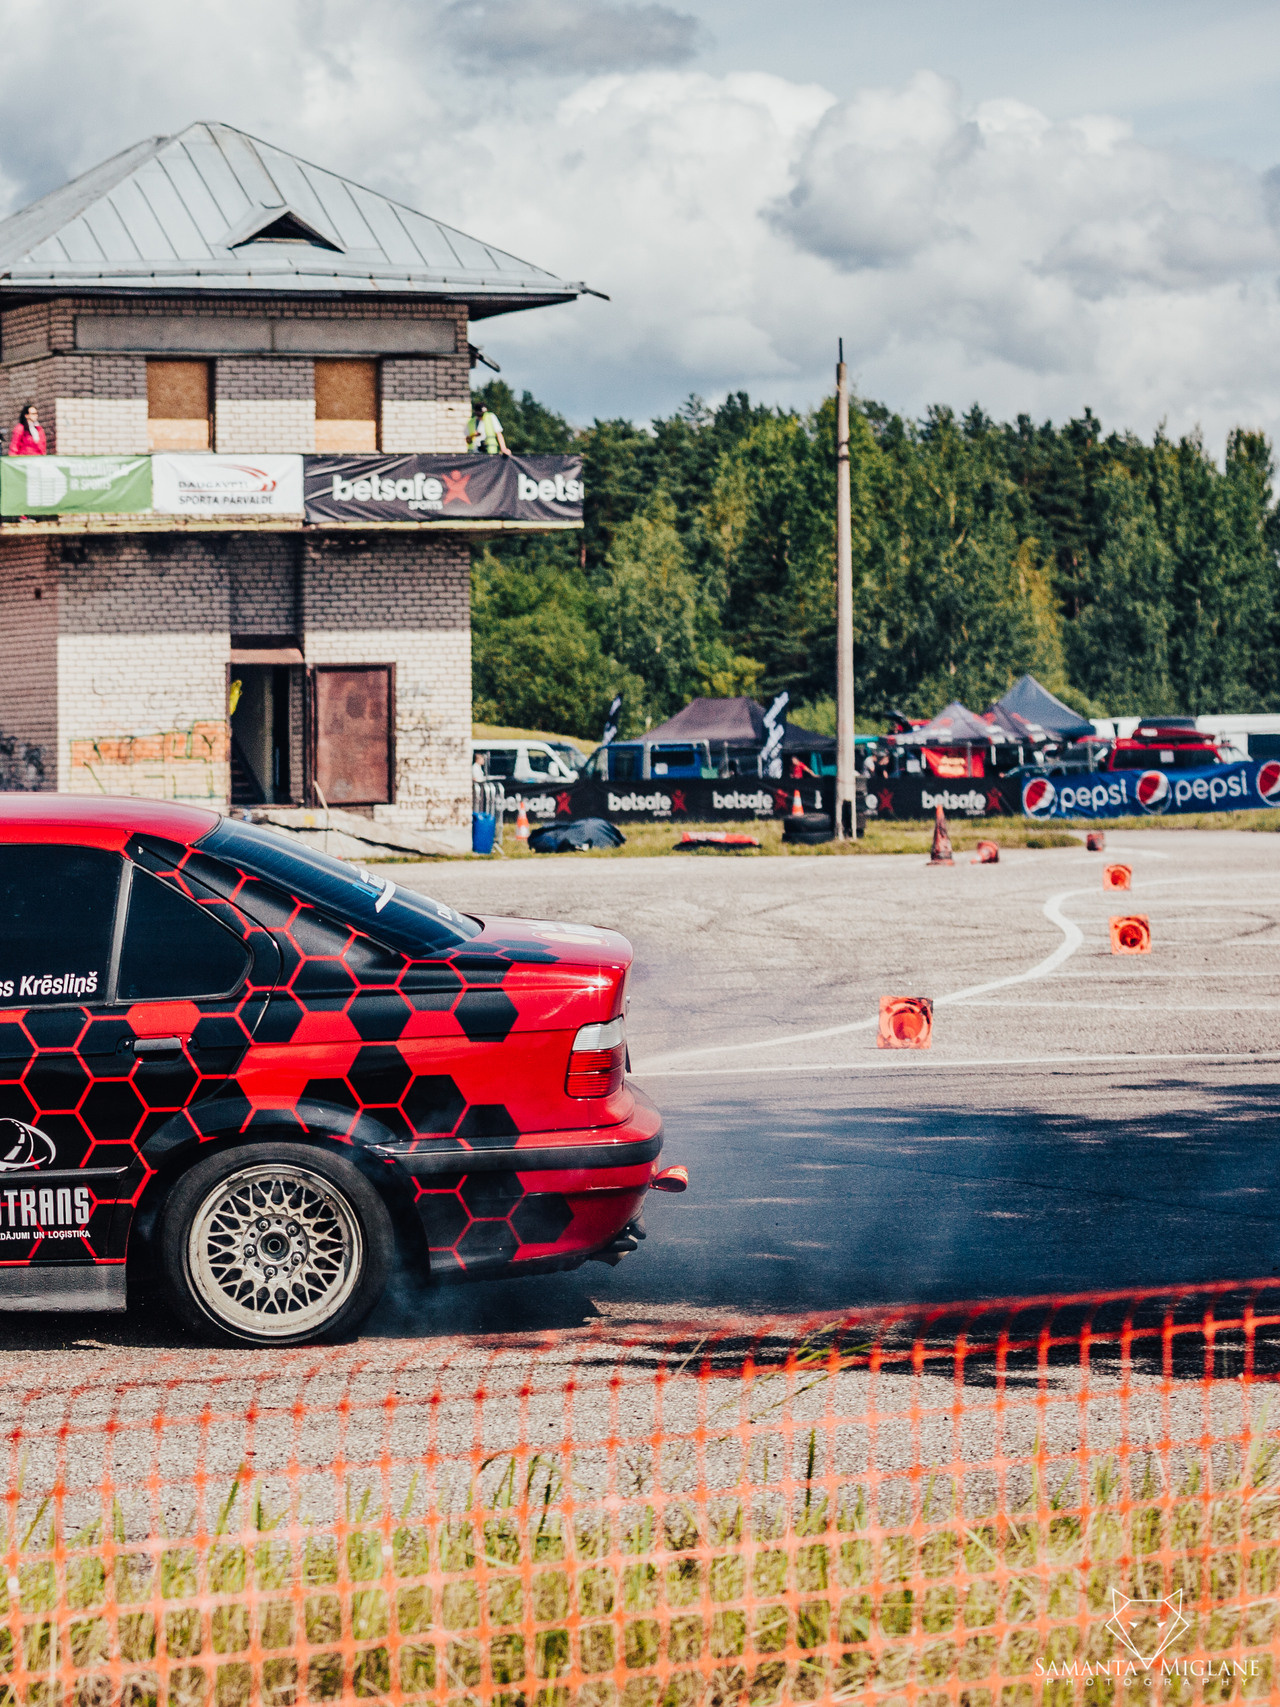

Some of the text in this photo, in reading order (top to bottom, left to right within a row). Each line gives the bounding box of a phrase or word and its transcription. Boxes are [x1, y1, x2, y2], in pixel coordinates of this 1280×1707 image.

[332, 473, 443, 501] betsafe
[713, 790, 773, 810] betsafe
[1060, 779, 1128, 812] pepsi
[1175, 770, 1248, 803] pepsi
[608, 792, 671, 811] betsafe
[19, 971, 99, 998] Krēsliņš
[33, 1231, 45, 1239] UN
[48, 1230, 91, 1242] LOĢISTIKA
